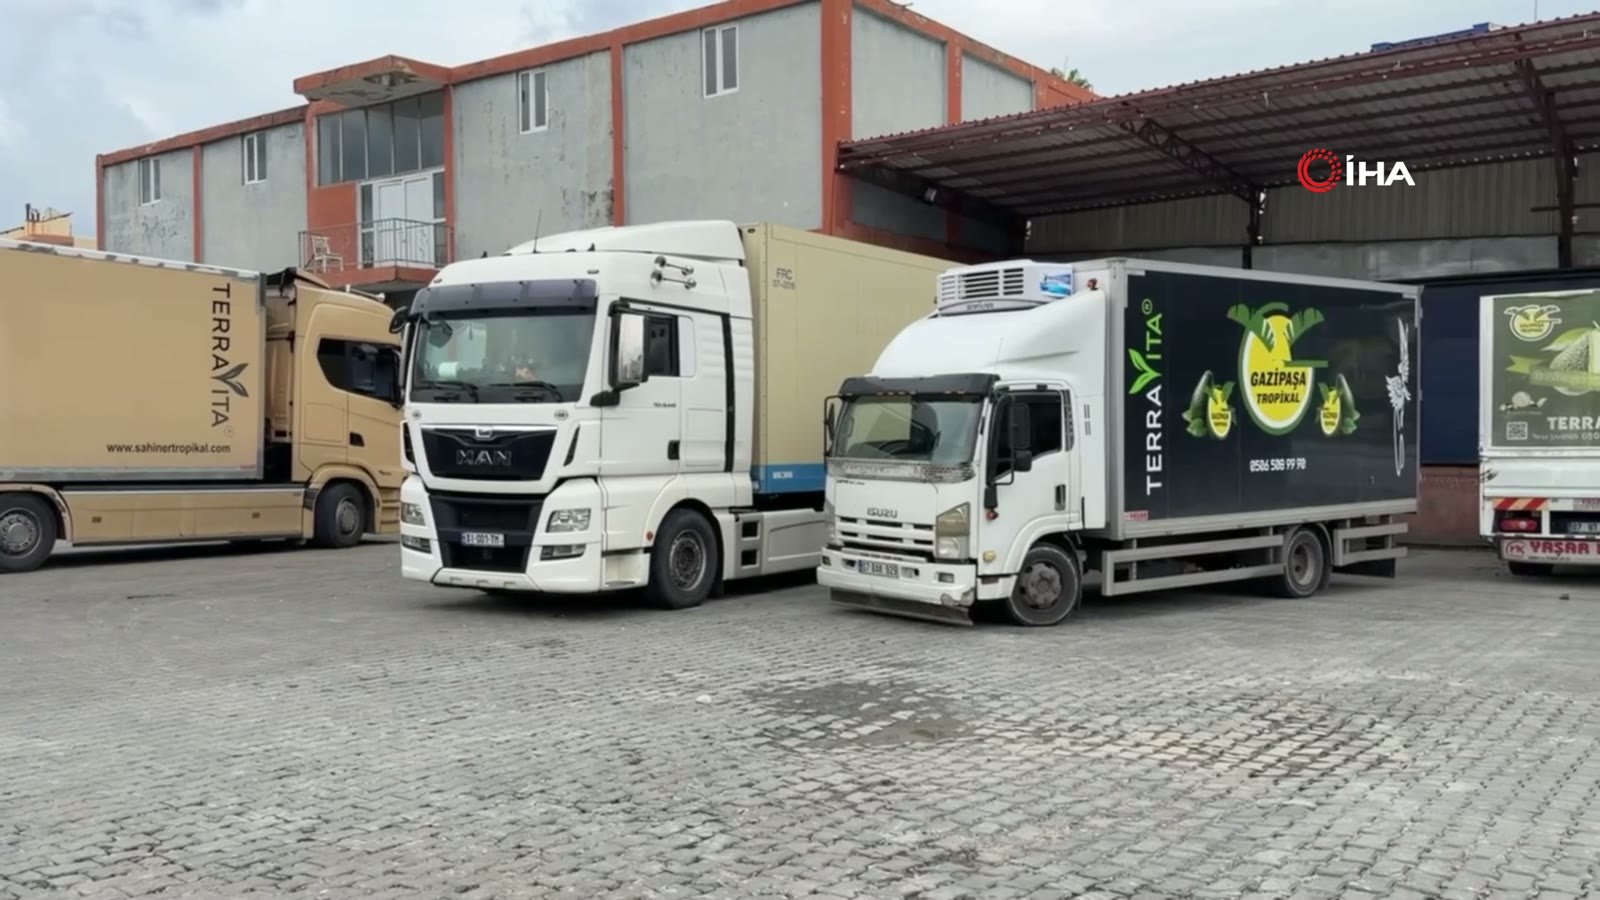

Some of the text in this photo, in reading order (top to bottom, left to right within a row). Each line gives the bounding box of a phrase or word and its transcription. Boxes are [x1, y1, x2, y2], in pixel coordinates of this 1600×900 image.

[1250, 367, 1306, 390] GAZİPAŞA
[1257, 390, 1300, 404] TROPİKAL
[106, 443, 231, 455] www.sahinertropikal.com
[456, 449, 512, 466] MAN
[867, 507, 898, 519] ISUZU
[1530, 541, 1590, 557] YAŞAR
